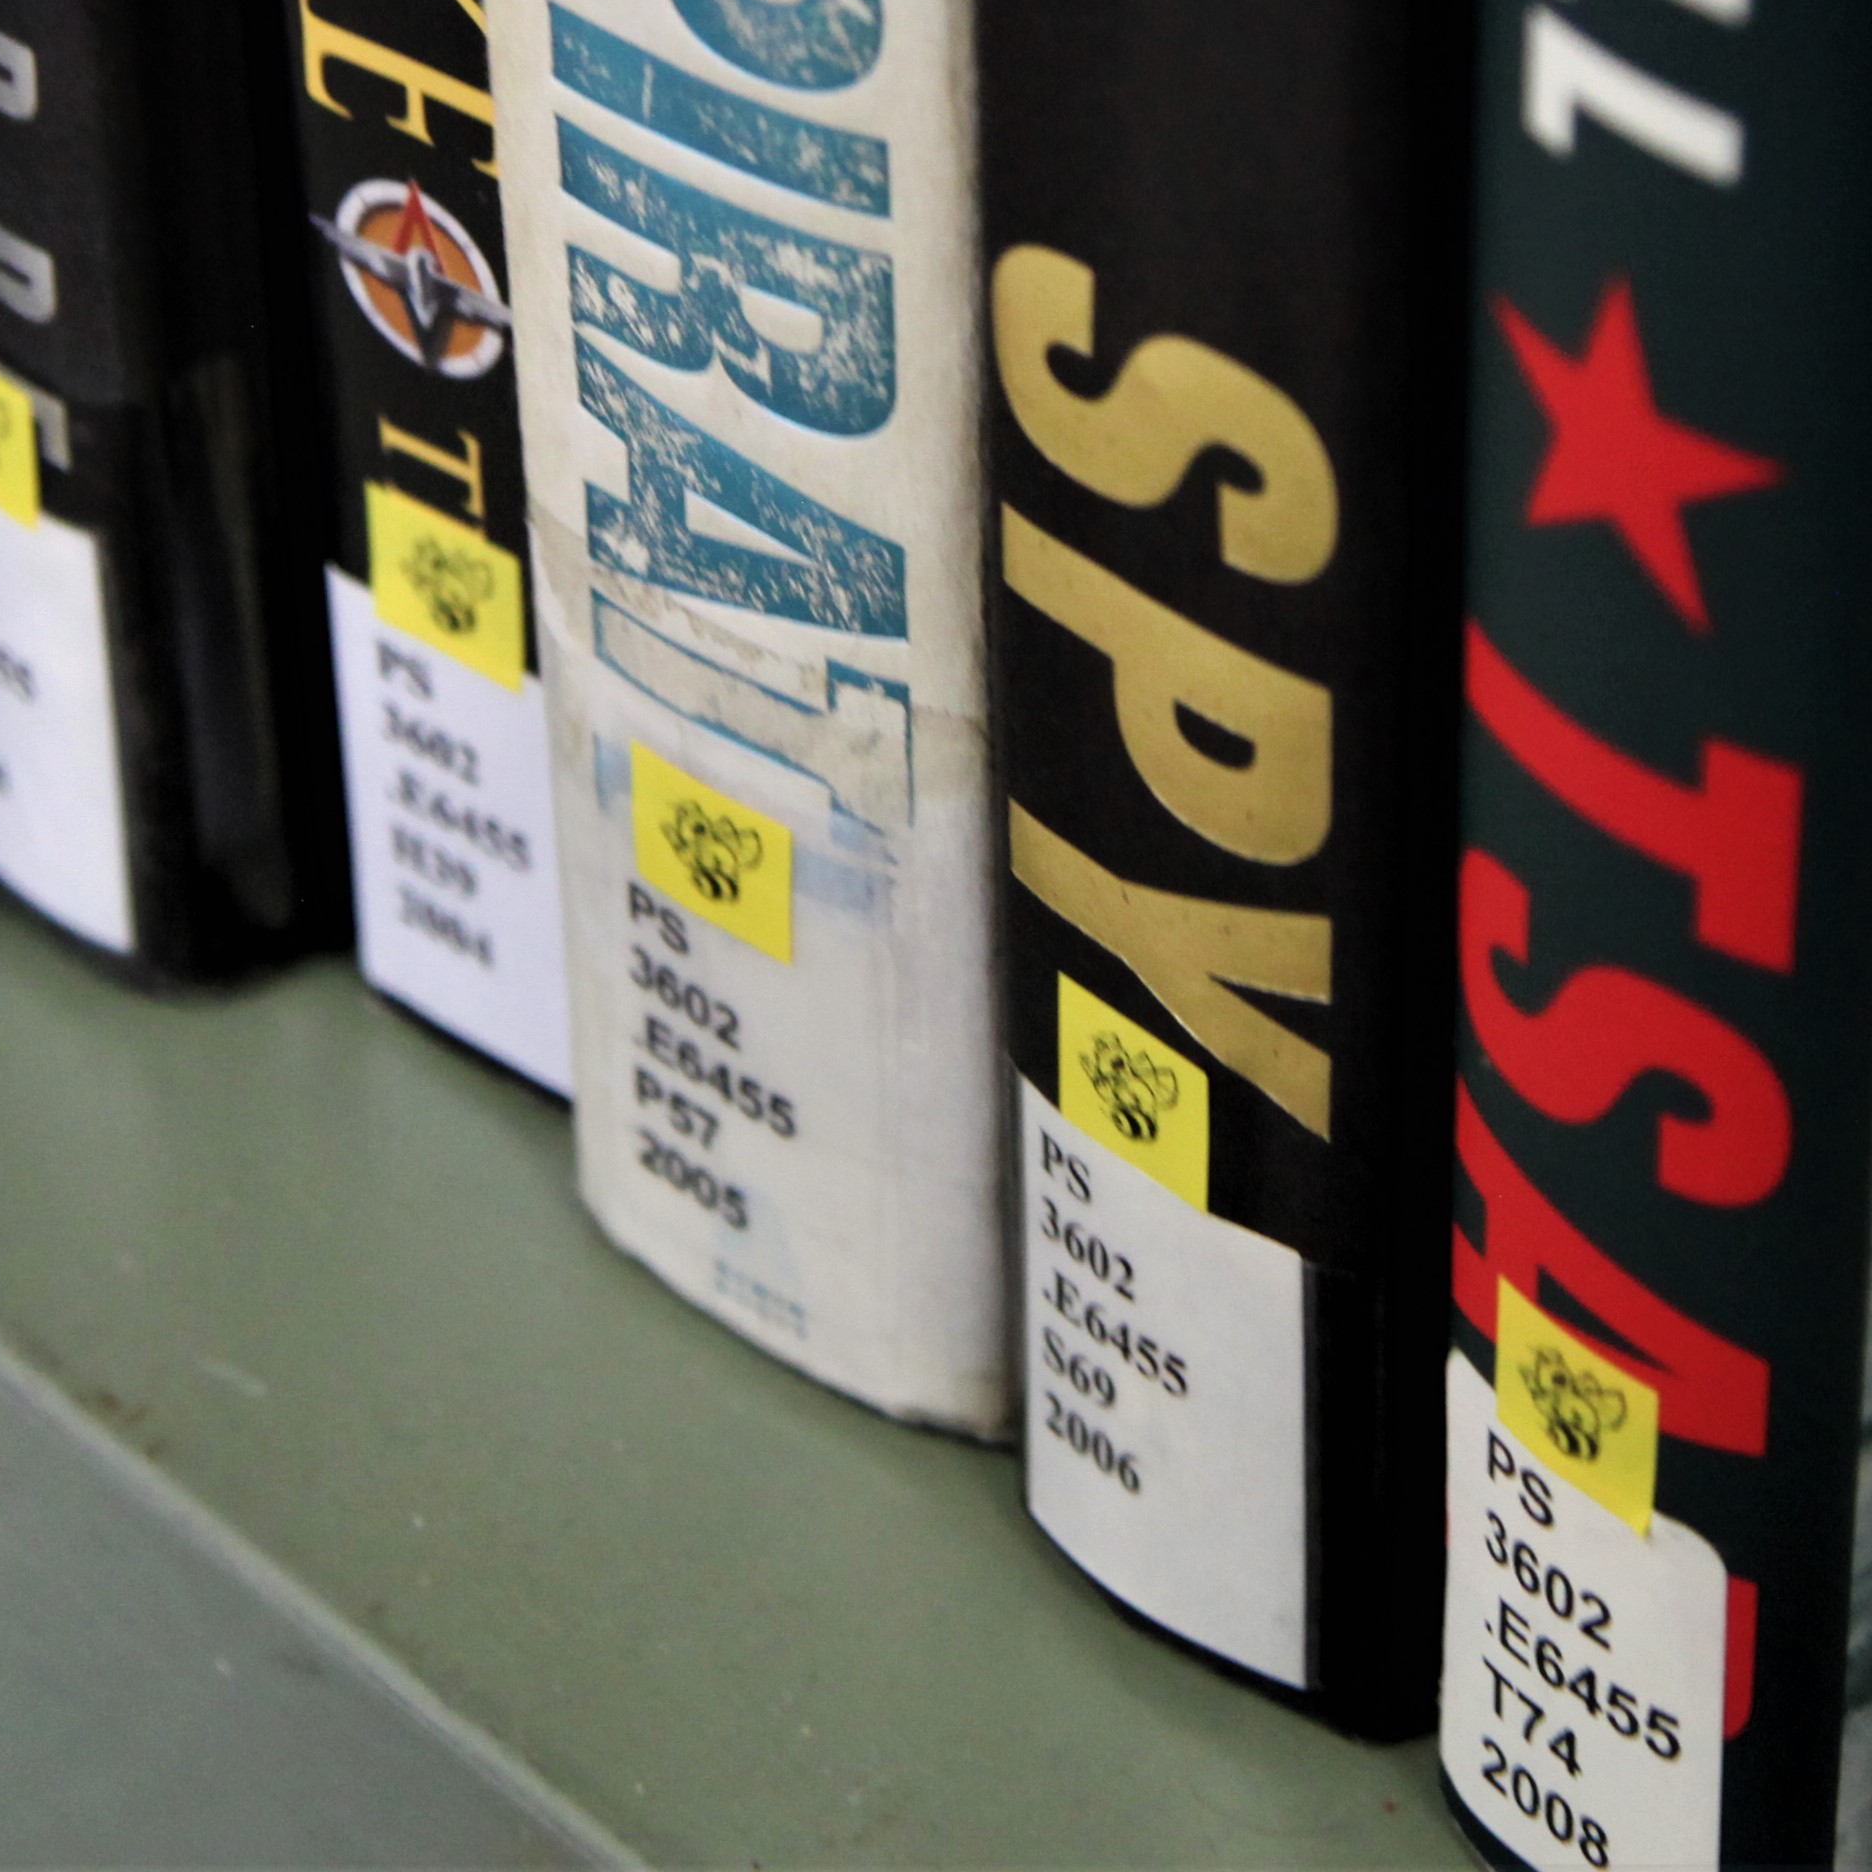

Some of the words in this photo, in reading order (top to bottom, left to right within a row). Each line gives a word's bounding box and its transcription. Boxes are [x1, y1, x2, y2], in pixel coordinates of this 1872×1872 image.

[990, 241, 1338, 1145] SPY
[629, 881, 691, 958] PS
[629, 946, 741, 1052] 3602
[635, 1070, 721, 1151] P57
[638, 1016, 799, 1141] .E6455
[636, 1130, 751, 1230] 2005
[1040, 1127, 1092, 1205] PS
[1448, 616, 1805, 1743] TSA
[1040, 1195, 1137, 1305] 3602
[1042, 1265, 1189, 1400] .E6455
[1042, 1323, 1117, 1411] S69
[1044, 1388, 1143, 1496] 2006
[1486, 1427, 1555, 1529] PS
[1484, 1508, 1614, 1653] 3602
[1481, 1654, 1584, 1778] T74
[1483, 1594, 1684, 1764] .E6455
[1479, 1734, 1612, 1871] 2008
